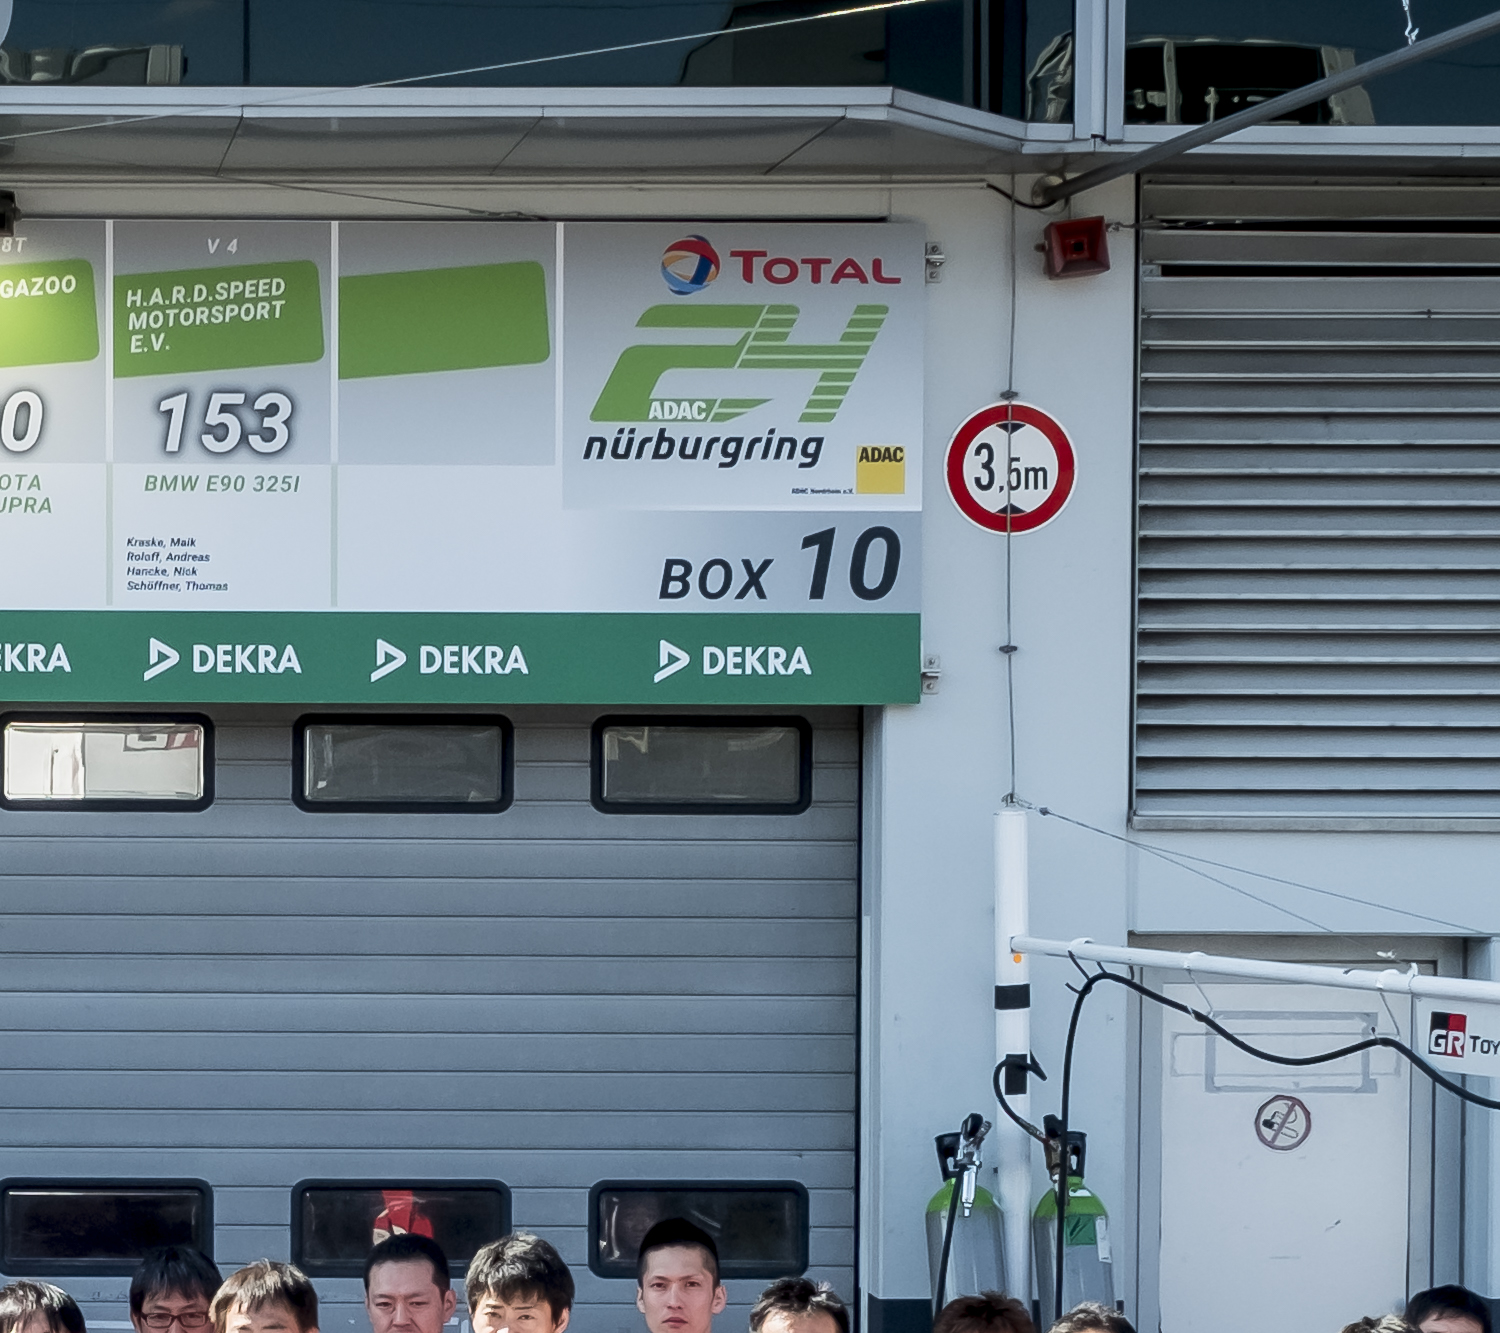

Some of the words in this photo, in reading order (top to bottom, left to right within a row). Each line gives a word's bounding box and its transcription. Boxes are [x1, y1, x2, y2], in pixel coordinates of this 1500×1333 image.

[730, 251, 901, 285] TOTAL
[0, 275, 76, 298] GAZOO
[126, 277, 286, 308] H.A.R.D.SPEED
[128, 299, 283, 331] MOTORSPORT
[130, 335, 170, 353] E.V.
[158, 392, 293, 455] 153
[649, 402, 706, 420] ADAC
[584, 429, 823, 469] nürburgring
[144, 475, 199, 492] BMW
[206, 476, 245, 492] E90
[659, 559, 774, 600] BOX
[800, 526, 901, 601] 10
[704, 646, 812, 677] DEKRA
